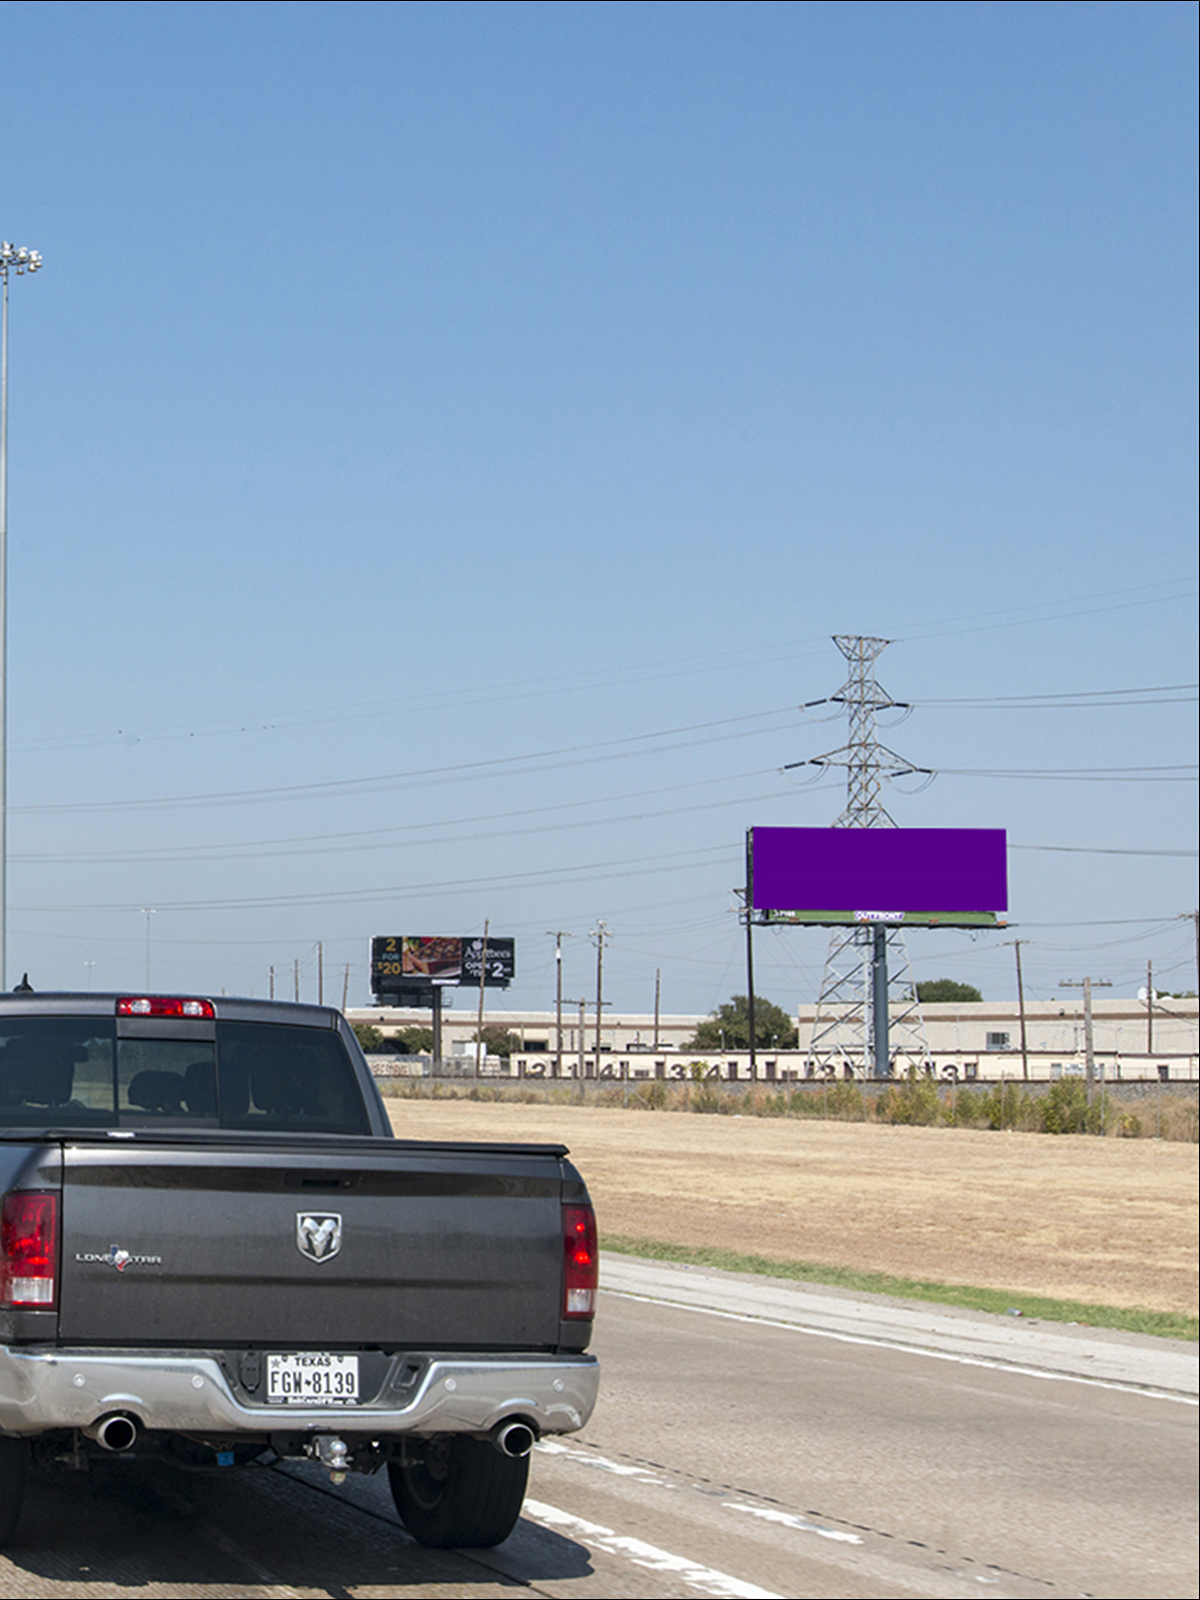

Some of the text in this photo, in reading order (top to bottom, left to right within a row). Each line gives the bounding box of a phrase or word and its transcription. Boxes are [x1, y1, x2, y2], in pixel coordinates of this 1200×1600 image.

[386, 939, 396, 951] 2
[382, 953, 399, 961] FOR
[378, 962, 401, 975] $20
[492, 962, 504, 977] 2
[294, 1356, 332, 1367] TEXAS
